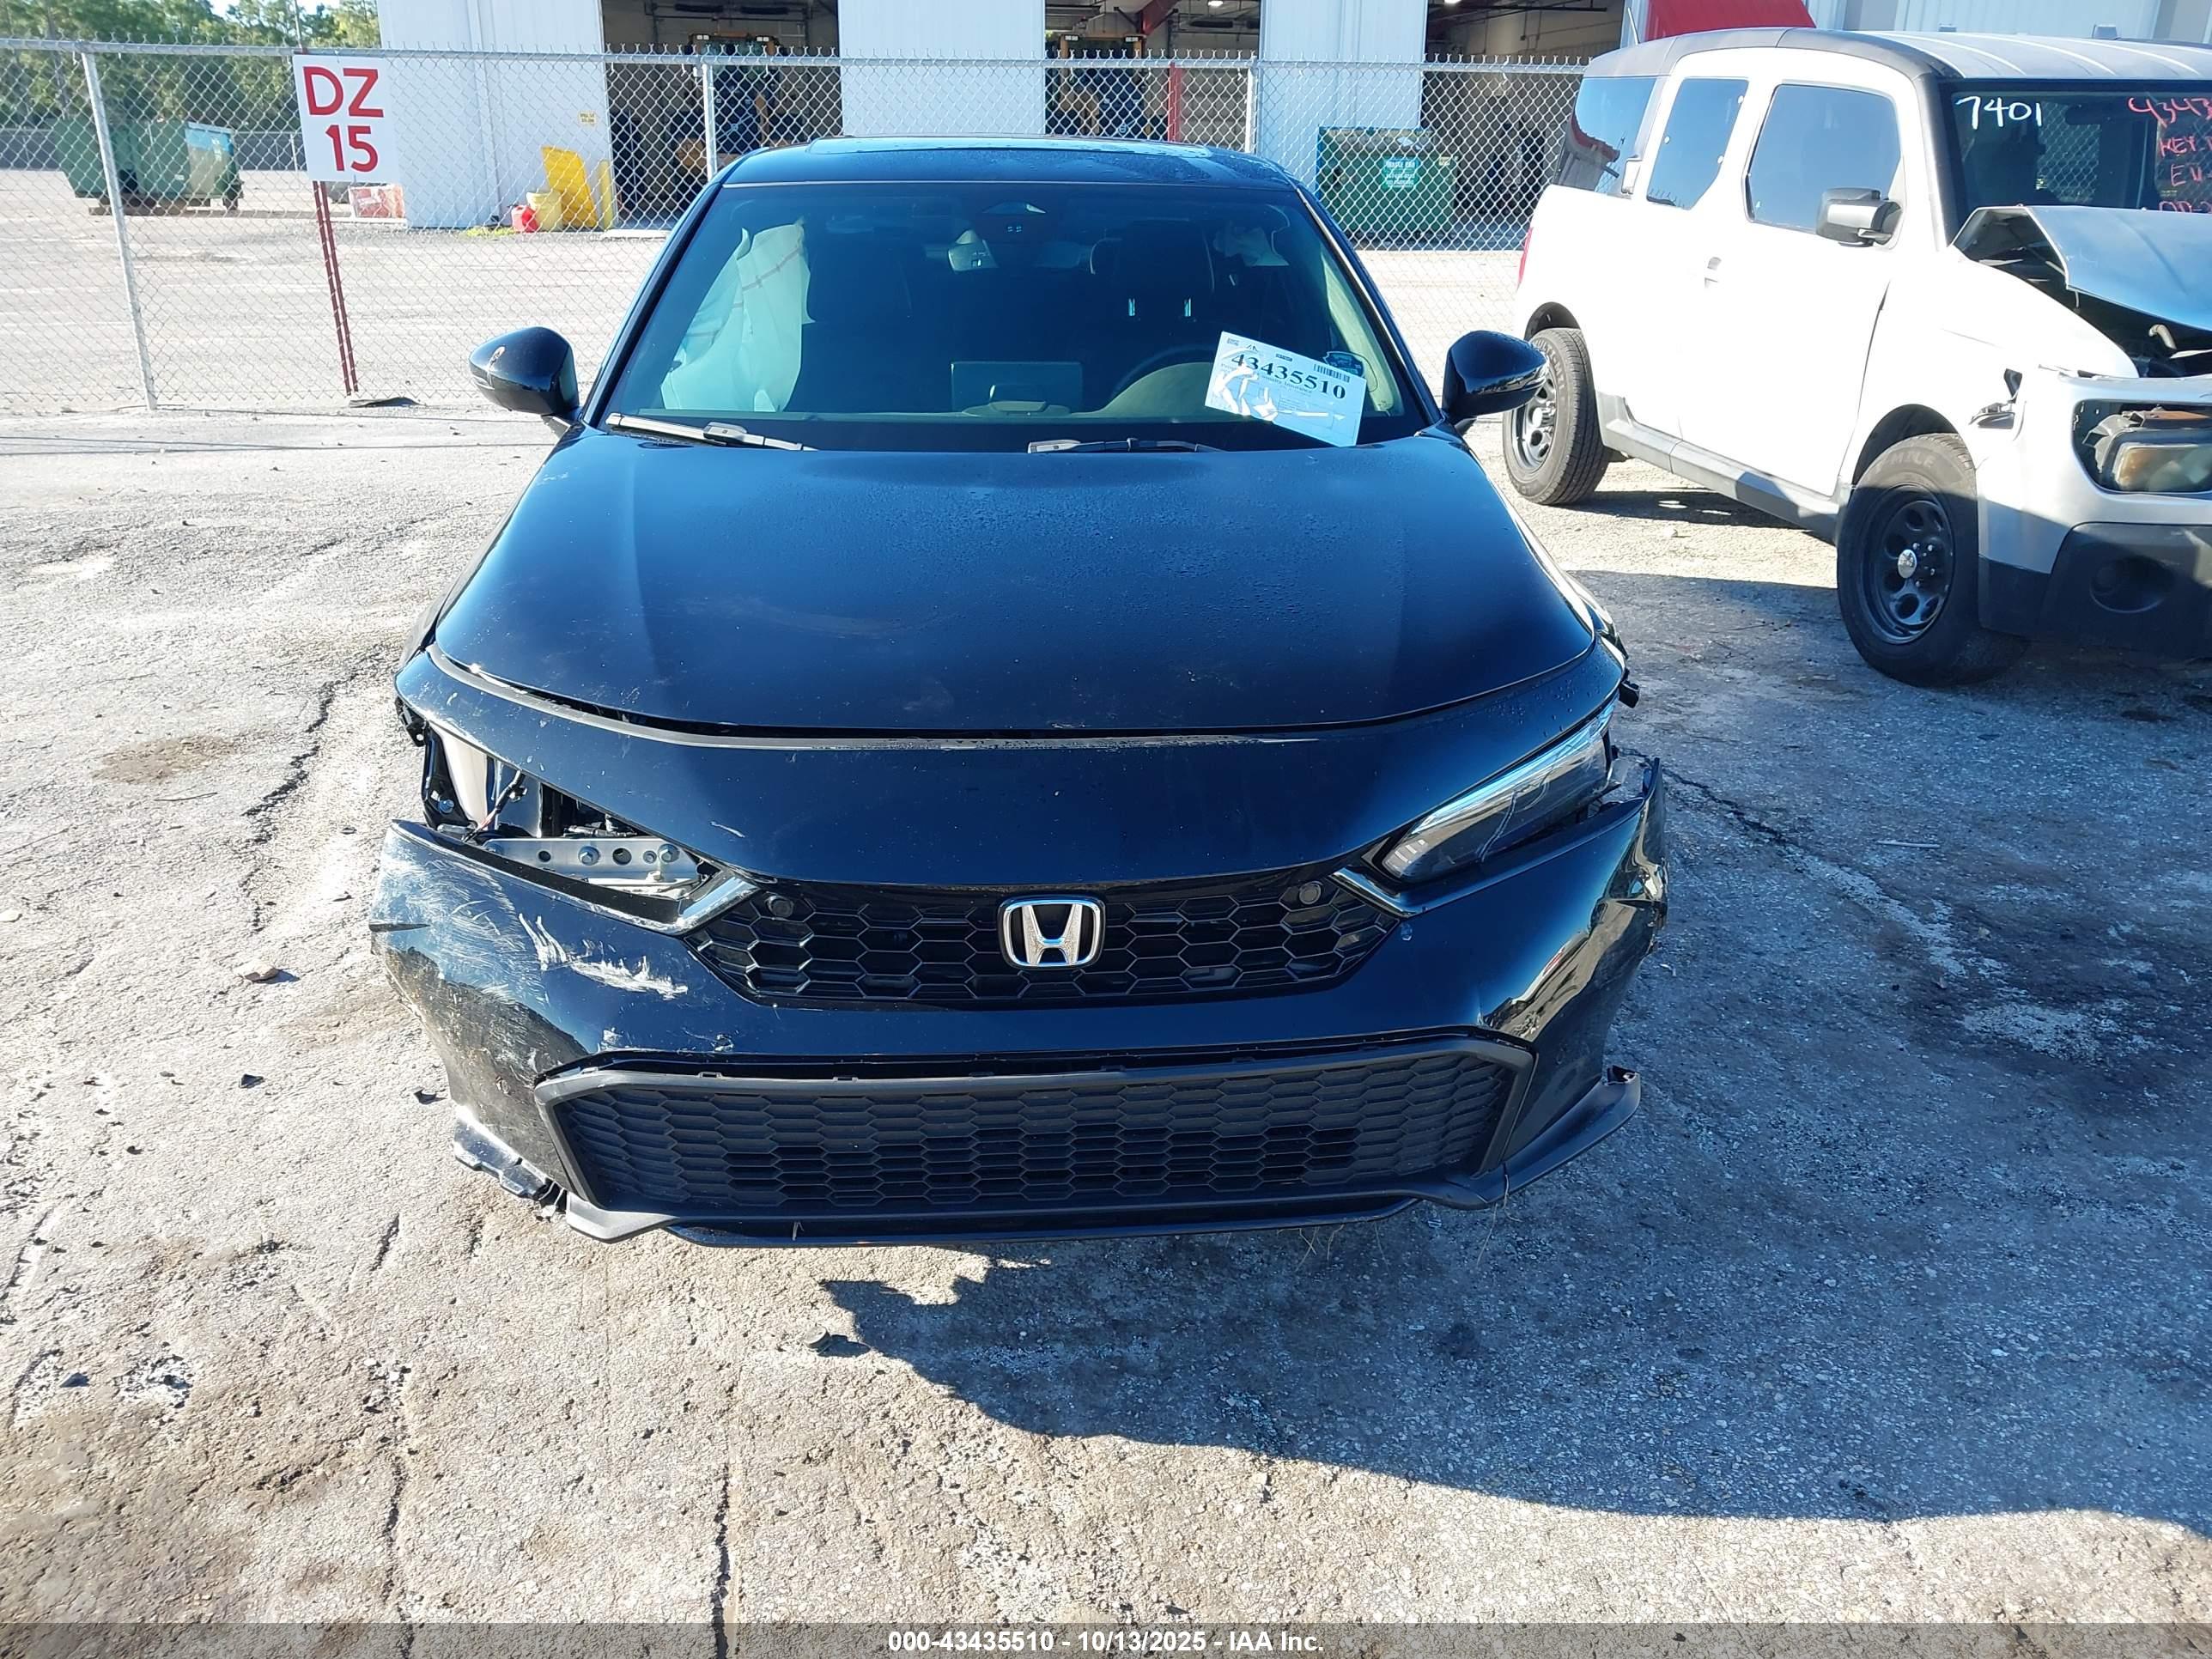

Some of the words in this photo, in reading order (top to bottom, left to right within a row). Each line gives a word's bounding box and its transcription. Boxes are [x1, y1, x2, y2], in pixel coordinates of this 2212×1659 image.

[303, 66, 384, 118] DZ
[1956, 95, 2043, 129] 7401
[325, 125, 378, 172] 15
[1231, 354, 1346, 399] 43435510
